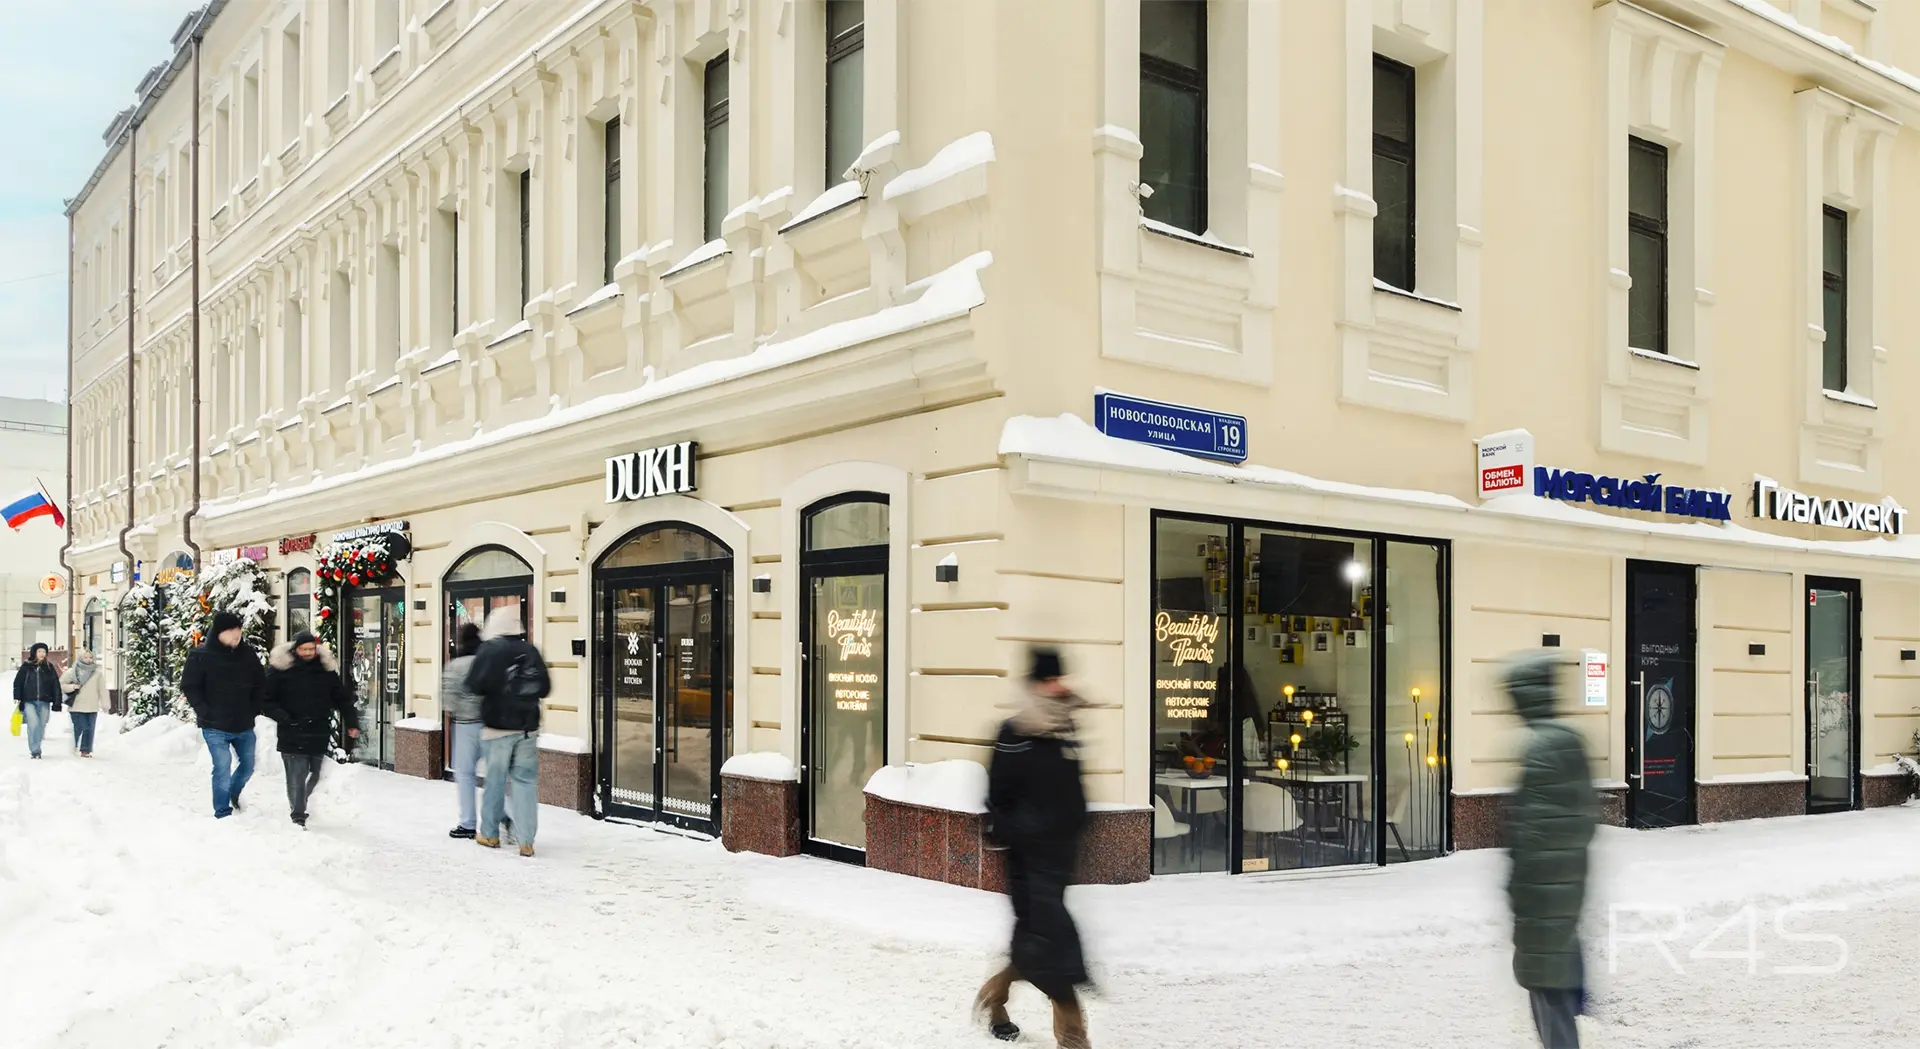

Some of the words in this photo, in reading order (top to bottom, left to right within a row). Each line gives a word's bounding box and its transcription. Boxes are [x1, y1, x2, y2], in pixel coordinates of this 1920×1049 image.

[1110, 406, 1211, 434] НОВОСЛОБОДСКАЯ
[1218, 418, 1241, 426] ВЛАДЕНИЕ
[1147, 430, 1176, 442] УЛИЦА
[1221, 425, 1240, 448] 19
[1217, 446, 1241, 454] СТРОЕНИЕ
[1482, 444, 1507, 452] МОРСКОЙ
[604, 441, 695, 504] DUKH
[1485, 469, 1514, 480] ОБМЕН
[1485, 477, 1522, 489] ВАЛЮТЫ
[1533, 466, 1662, 512] МОРСКОЙ
[1666, 485, 1732, 521] БАНК
[1754, 480, 1908, 535] Гиалджект
[827, 609, 877, 638] Beautiful
[1155, 611, 1219, 643] Beautiful
[837, 633, 872, 661] Flavors
[1170, 638, 1214, 666] Flavors
[1641, 643, 1679, 655] ВЫГОДНЫЙ
[1641, 656, 1660, 666] КУРС
[624, 677, 642, 685] KITCHEN
[828, 672, 855, 683] ВКУСНЫЙ
[1156, 679, 1191, 690] ВКУСНЫЙ
[1193, 681, 1217, 690] КОФЕ
[835, 689, 870, 700] АВТОРСКИЕ
[837, 700, 868, 711] КОКТЕЙЛИ
[1165, 696, 1210, 707] АВТОРСКИЕ
[1167, 708, 1208, 719] КОКТЕЙЛИ
